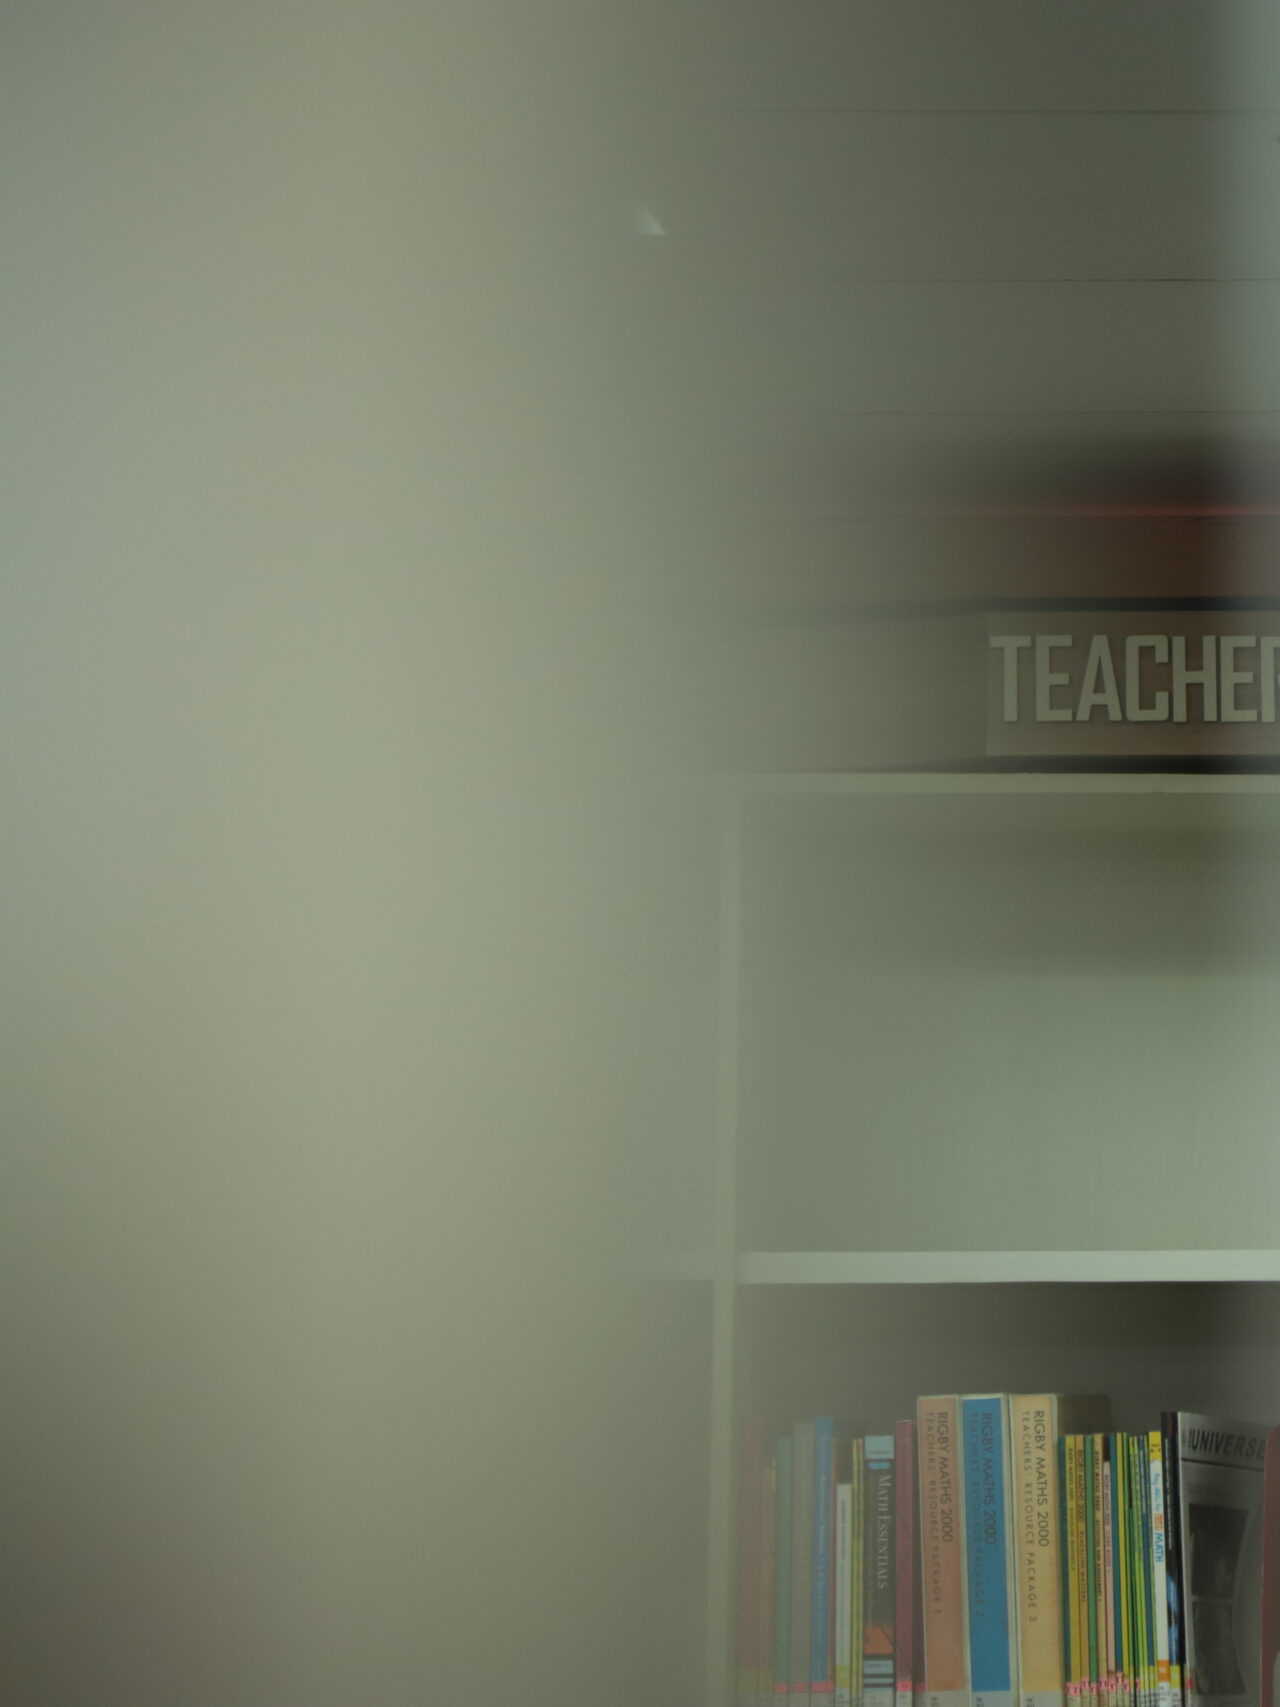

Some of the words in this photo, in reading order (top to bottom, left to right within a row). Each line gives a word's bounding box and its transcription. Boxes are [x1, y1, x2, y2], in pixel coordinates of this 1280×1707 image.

[936, 1411, 949, 1453] RIGBY
[981, 1412, 994, 1455] RIGBY
[1033, 1410, 1046, 1452] RIGBY
[938, 1456, 951, 1505] MATHS
[983, 1457, 995, 1506] MATHS
[1035, 1457, 1048, 1506] MATHS
[928, 1481, 939, 1541] RESOURCE
[940, 1508, 954, 1543] 2000
[984, 1510, 997, 1545] 2000
[1024, 1483, 1035, 1545] RESOURCE
[1037, 1511, 1050, 1547] 2000
[1154, 1532, 1164, 1563] MATH
[1026, 1552, 1037, 1609] PACKAGE
